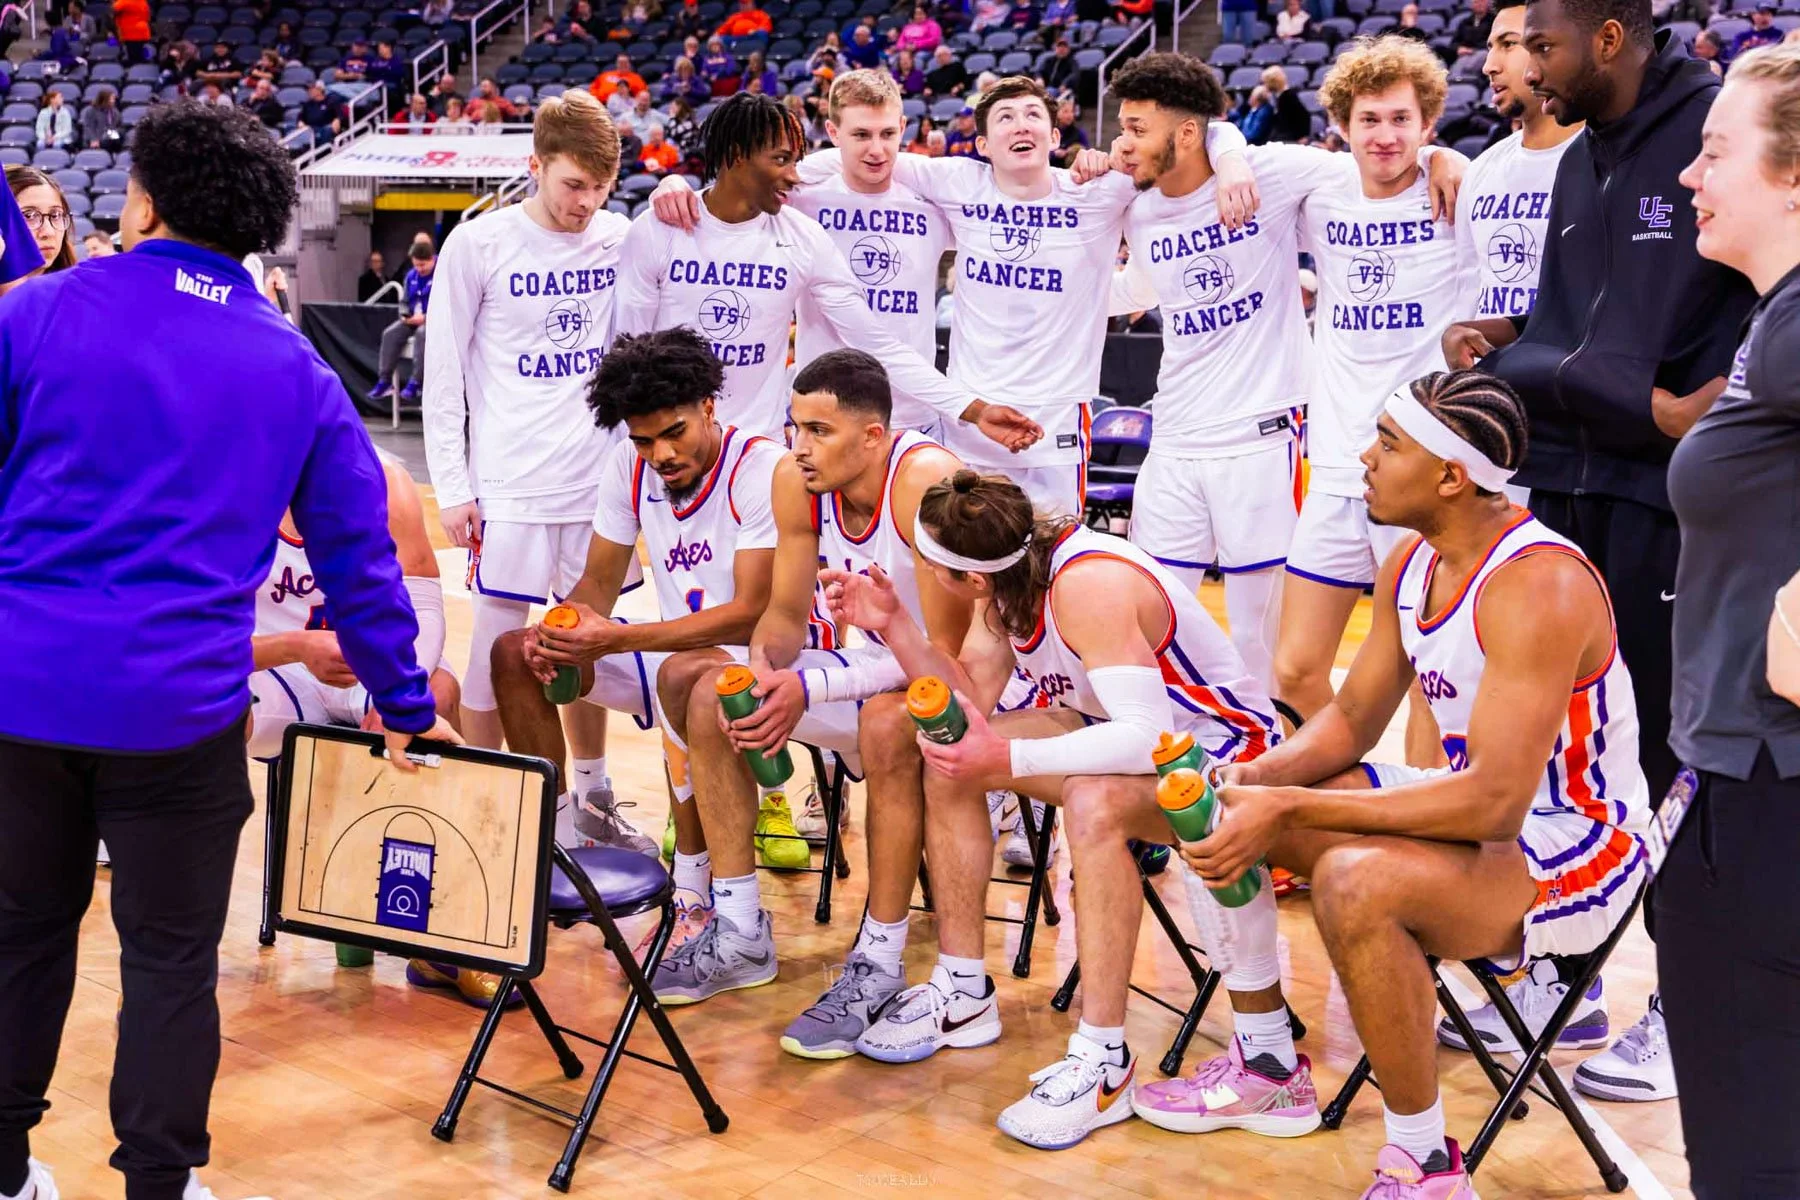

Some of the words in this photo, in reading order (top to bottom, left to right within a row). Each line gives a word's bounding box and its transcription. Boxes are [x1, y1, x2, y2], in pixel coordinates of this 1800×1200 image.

[962, 203, 1079, 228] COACHES
[1471, 192, 1551, 221] COACH
[1639, 196, 1673, 228] UE
[818, 208, 927, 236] COACHES
[1326, 219, 1435, 247] COACHES
[1003, 227, 1029, 246] VS
[1150, 214, 1260, 263] COACHES
[1631, 231, 1673, 242] BASKETBALL
[863, 251, 889, 270] VS
[1499, 243, 1525, 263] VS
[175, 267, 233, 305] VALLEY
[510, 268, 616, 297] COACHES
[669, 259, 788, 291] COACHES
[966, 256, 1063, 293] CANCER
[1195, 270, 1223, 291] VS
[1359, 265, 1383, 284] VS
[863, 288, 919, 314] NCER
[1173, 291, 1264, 336] CANCER
[557, 313, 582, 332] VS
[713, 306, 739, 325] VS
[1333, 302, 1425, 331] CANCER
[518, 346, 604, 378] CANCE
[383, 846, 431, 881] VALLEY
